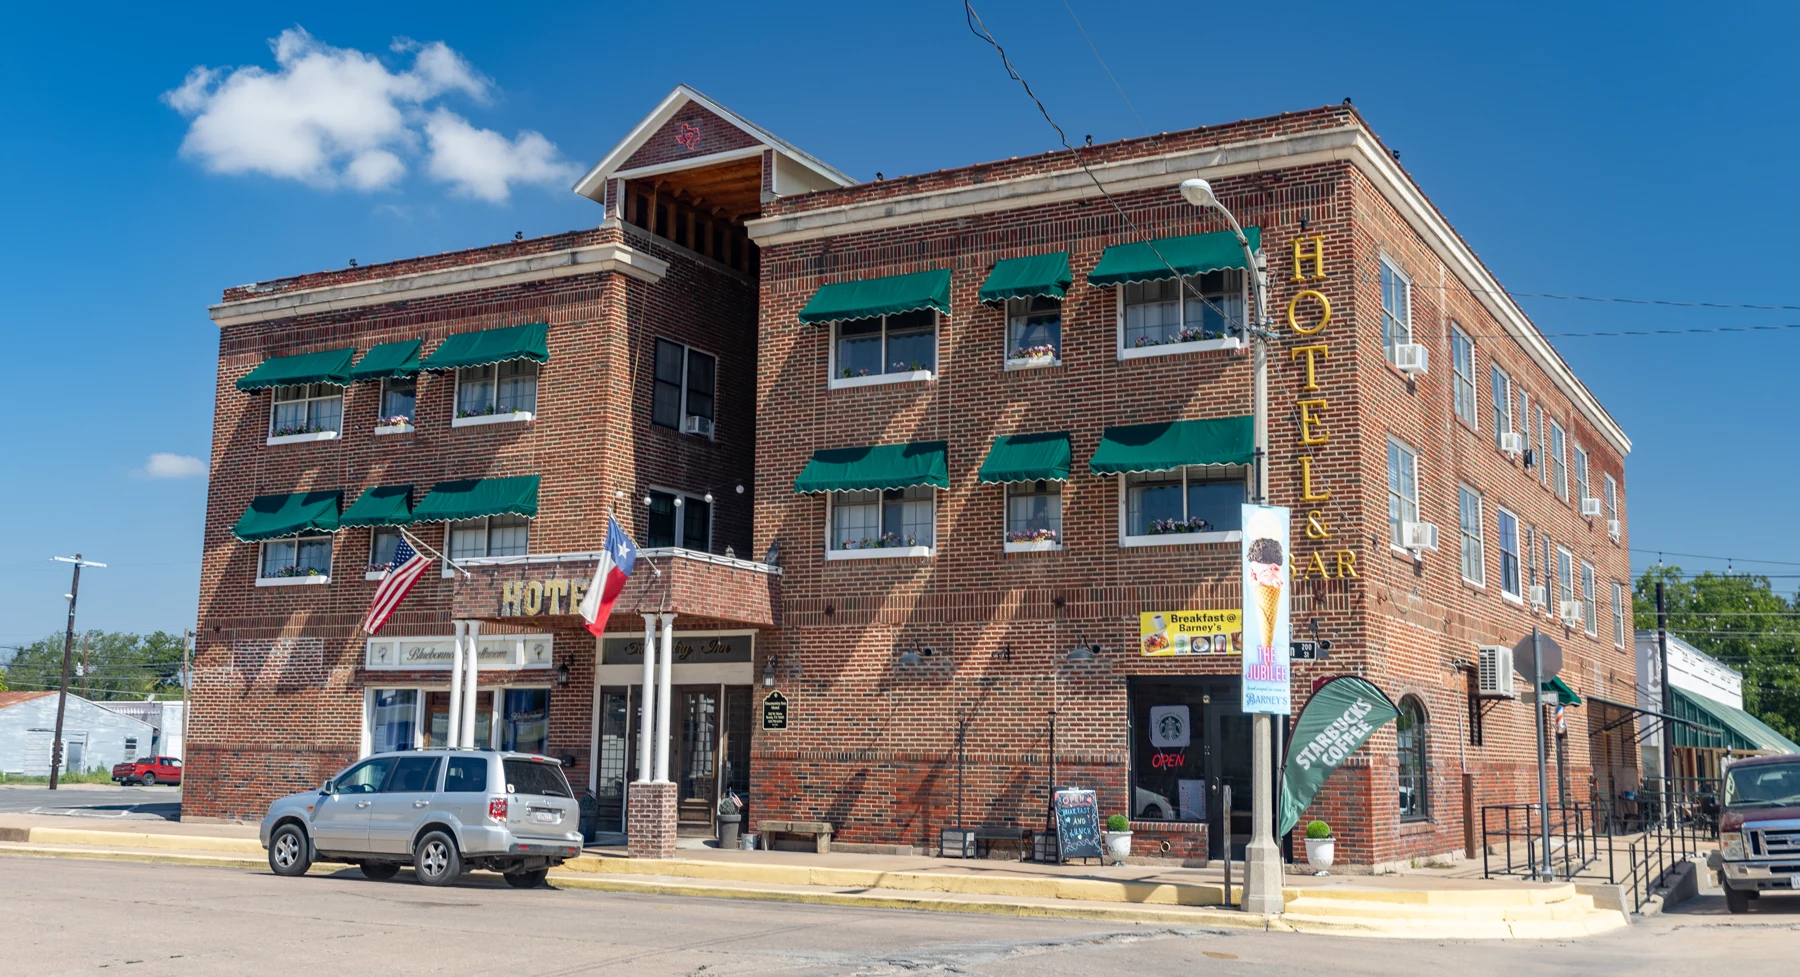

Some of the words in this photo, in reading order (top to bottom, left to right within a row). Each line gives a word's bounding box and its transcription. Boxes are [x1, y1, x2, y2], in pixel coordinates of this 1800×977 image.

[1287, 235, 1332, 500] HOTEL
[1306, 510, 1332, 539] &
[501, 579, 590, 616] HOTE
[1171, 613, 1225, 623] Breakfast
[1226, 613, 1236, 623] @
[1179, 623, 1222, 633] Barney's
[701, 639, 731, 654] Inn
[1301, 643, 1312, 651] 200
[1258, 646, 1276, 663] THE
[1246, 664, 1287, 682] JUBILEE
[1246, 692, 1288, 706] BARNEY'S
[1296, 697, 1372, 771] STARBUCKS
[1322, 720, 1373, 767] COFFEE
[1151, 753, 1185, 768] OPEN
[1062, 794, 1085, 805] OPEN
[1072, 817, 1086, 825] AND
[1069, 827, 1092, 837] LUNCH
